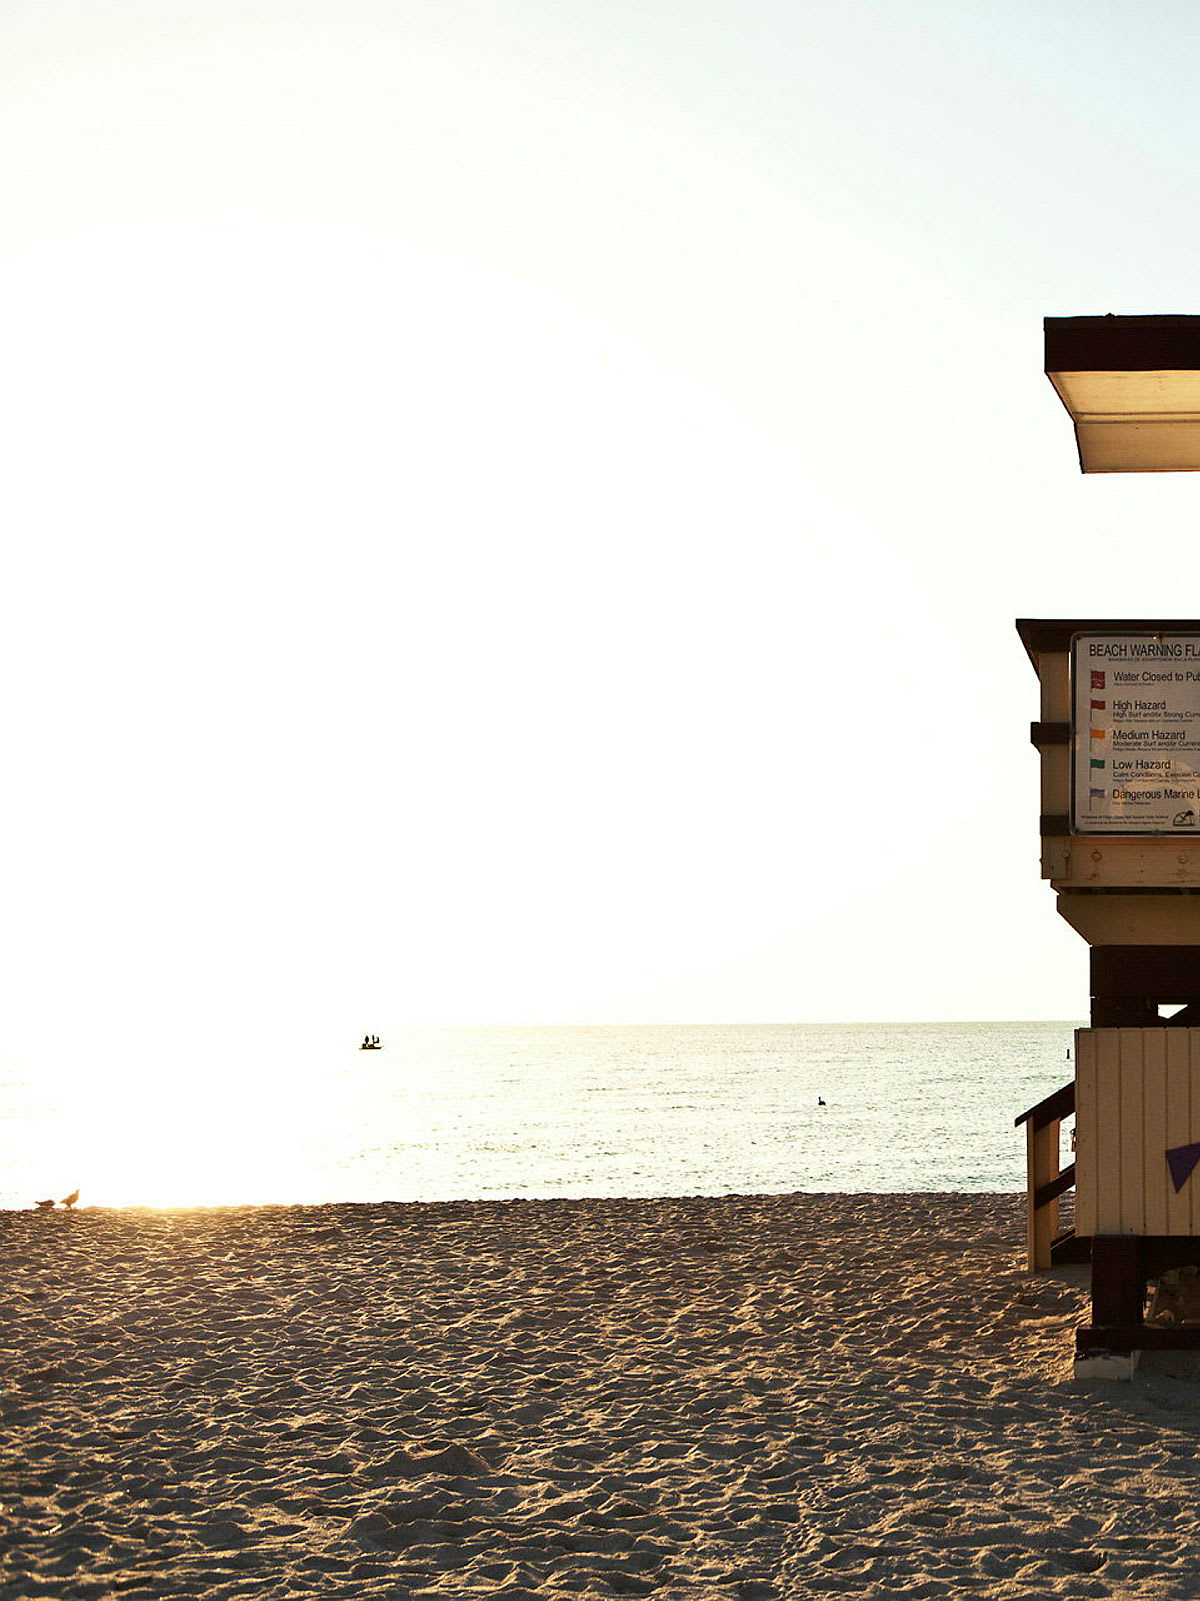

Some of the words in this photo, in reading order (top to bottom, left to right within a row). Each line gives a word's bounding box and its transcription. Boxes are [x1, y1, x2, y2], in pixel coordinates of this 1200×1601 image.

[1089, 643, 1127, 657] BEACH
[1129, 643, 1182, 657] WARNING
[1113, 672, 1140, 682] Water
[1142, 671, 1173, 682] Closed
[1175, 672, 1183, 681] to
[1113, 701, 1132, 711] High
[1135, 700, 1166, 710] Hazard
[1113, 711, 1127, 719] High
[1112, 730, 1149, 740] Medium
[1151, 730, 1186, 740] Hazard
[1112, 759, 1133, 769] Low
[1135, 759, 1171, 769] Hazard
[1112, 788, 1162, 801] Dangerous
[1164, 788, 1194, 799] Marine
